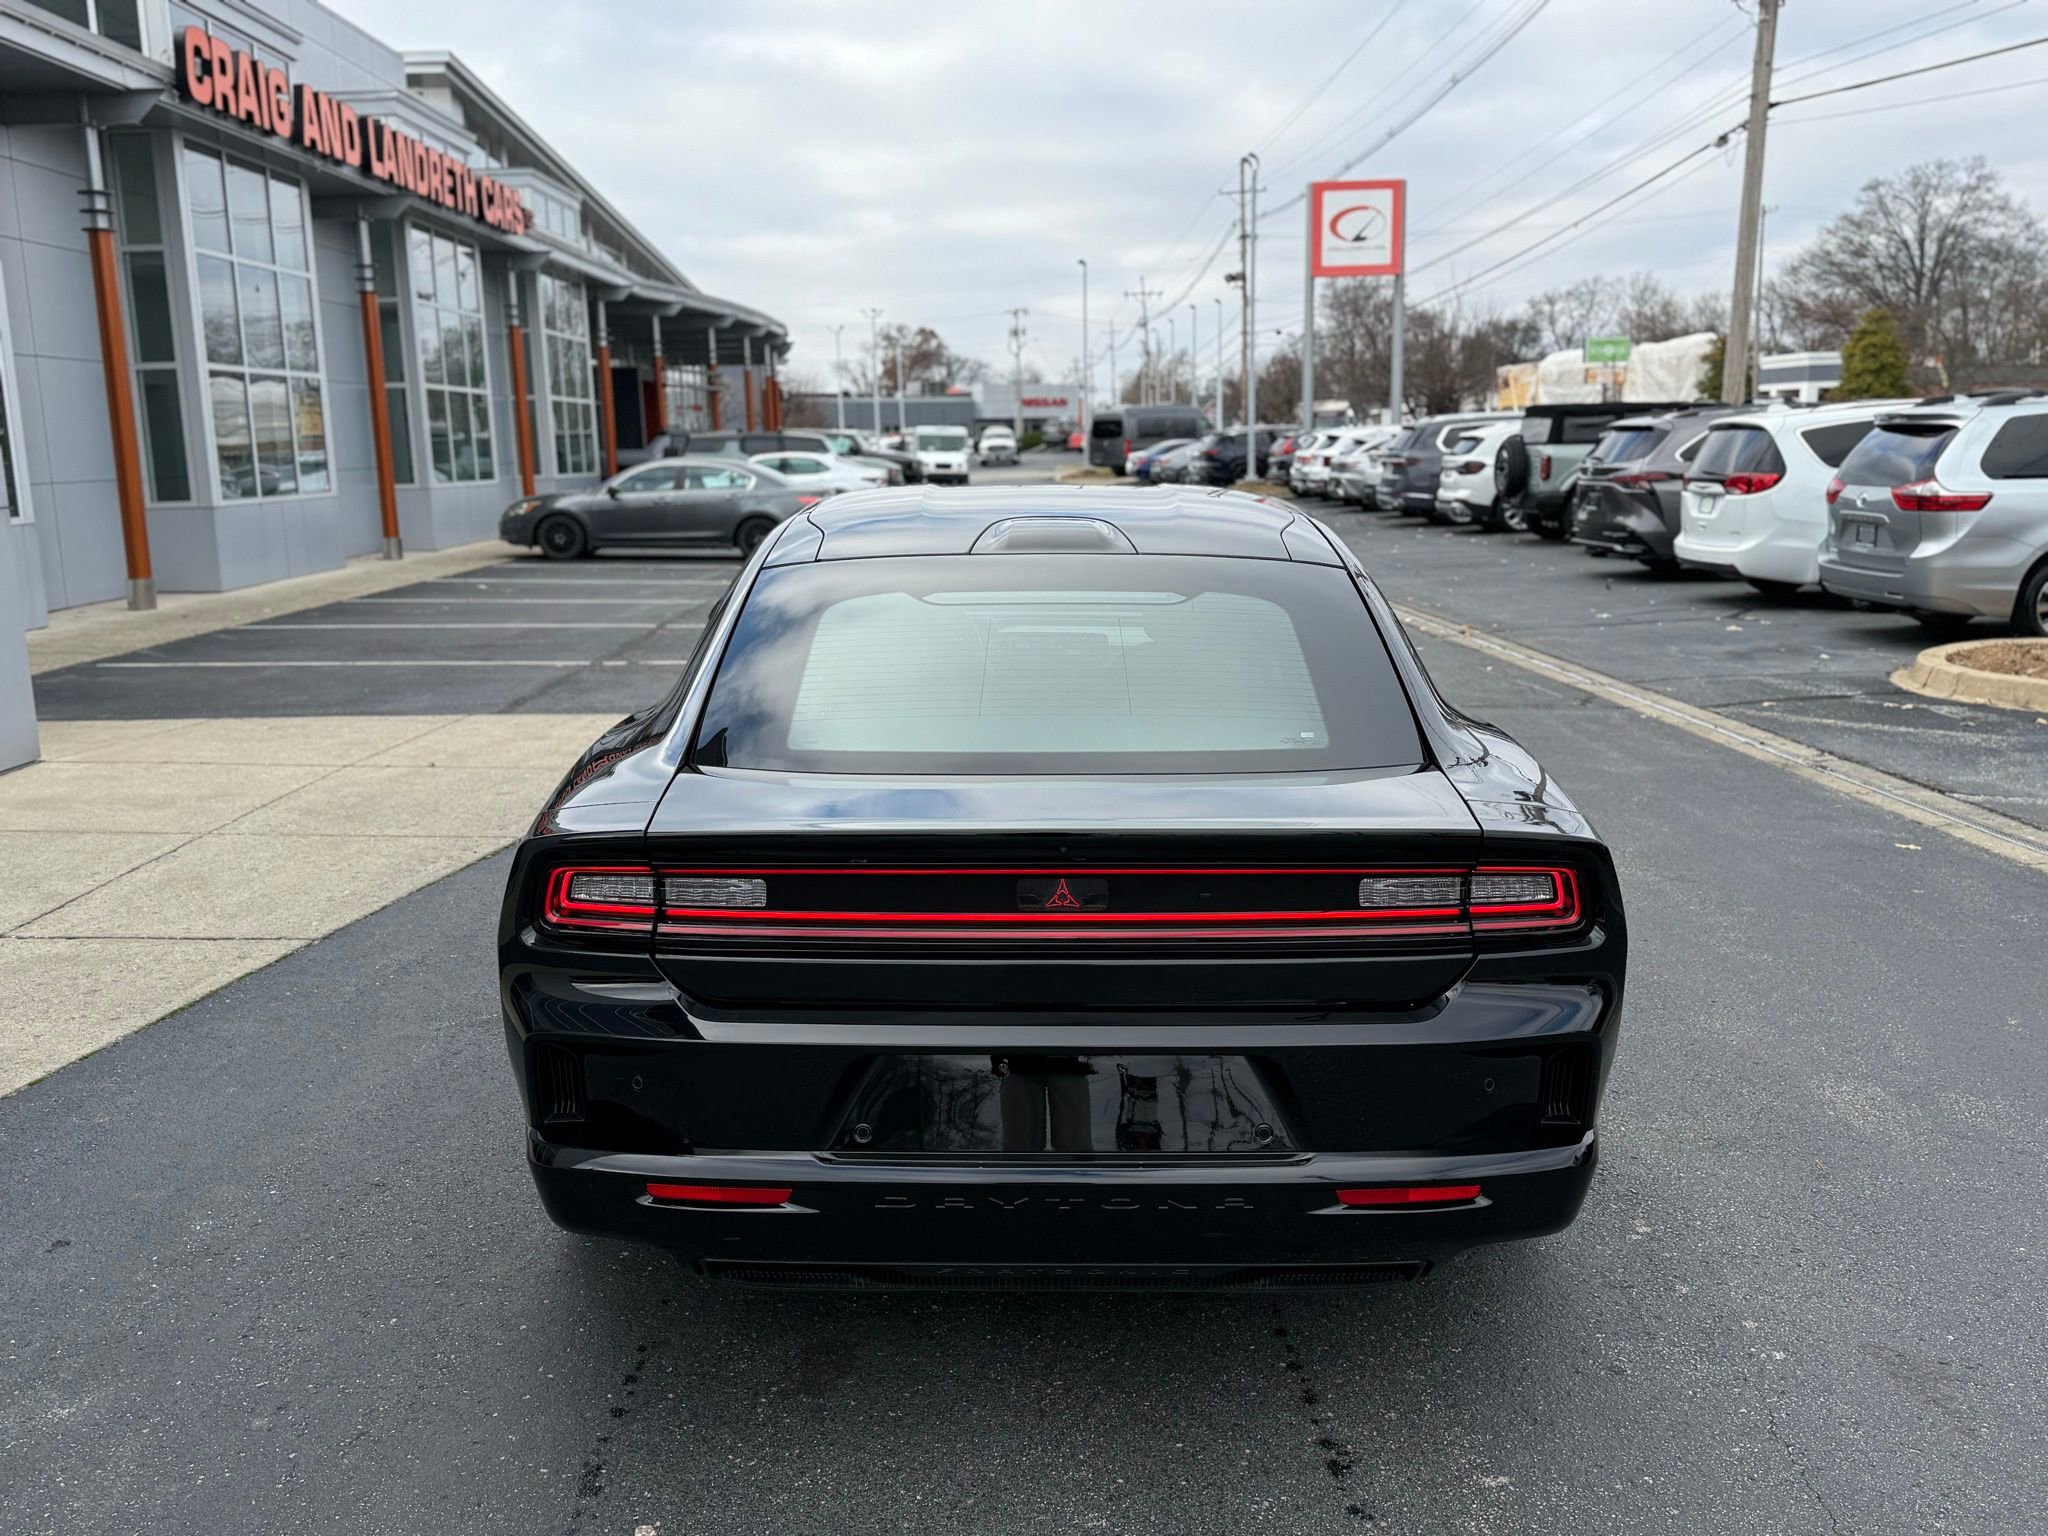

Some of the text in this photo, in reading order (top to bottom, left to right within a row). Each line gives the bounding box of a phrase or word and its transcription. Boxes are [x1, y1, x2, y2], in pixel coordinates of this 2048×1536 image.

[182, 25, 525, 235] CRAIG AND LANDRETH CARS
[1022, 397, 1069, 408] NISSAN
[873, 1195, 1255, 1211] DAYTONA
